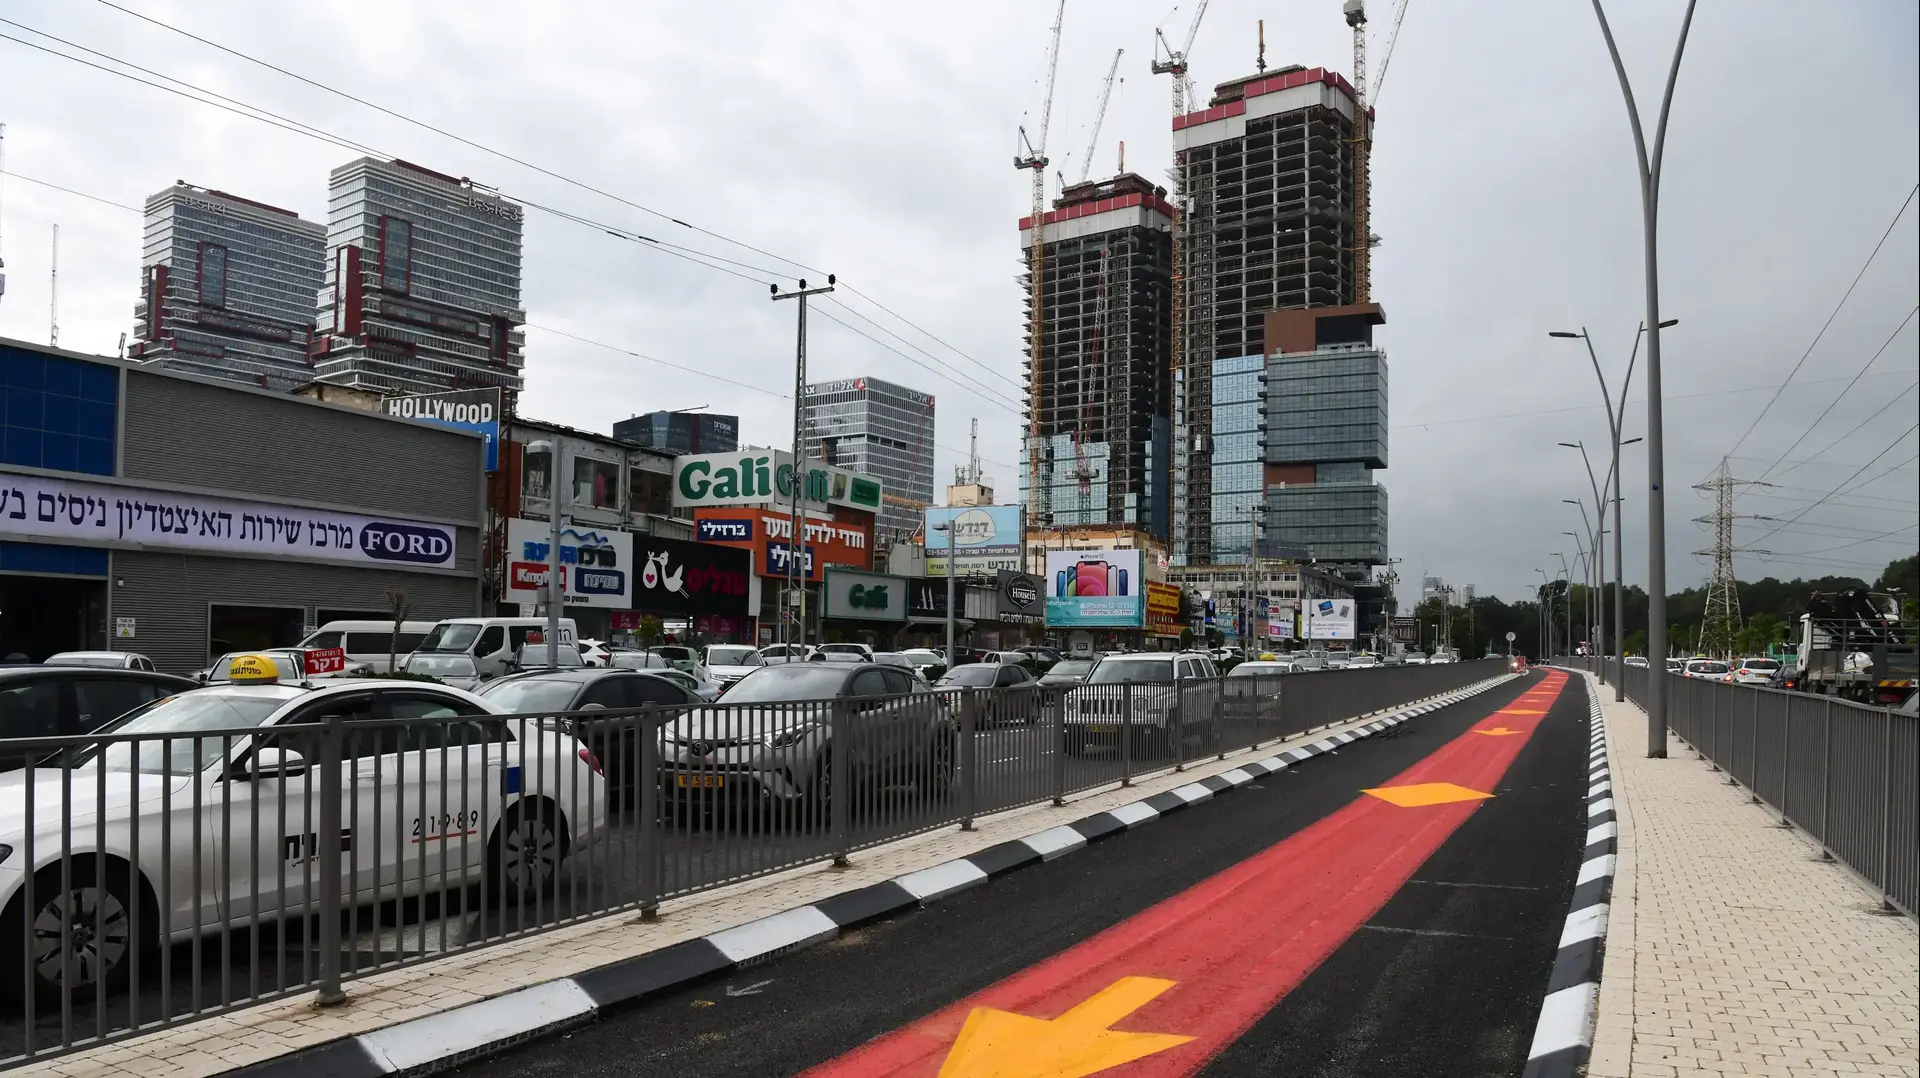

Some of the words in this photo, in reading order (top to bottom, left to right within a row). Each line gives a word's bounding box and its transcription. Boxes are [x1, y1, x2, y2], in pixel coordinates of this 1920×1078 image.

[389, 398, 493, 424] HOLLYWOOD
[679, 457, 772, 500] Gali
[37, 490, 106, 527] ניסים
[116, 499, 233, 539] האיצטדיון
[240, 512, 302, 545] שירות
[308, 520, 353, 549] מרכז
[702, 522, 747, 537] ברזילי
[761, 515, 796, 540] נוער
[837, 528, 865, 549] חדרי
[365, 529, 448, 556] FORD
[309, 657, 341, 672] דקר
